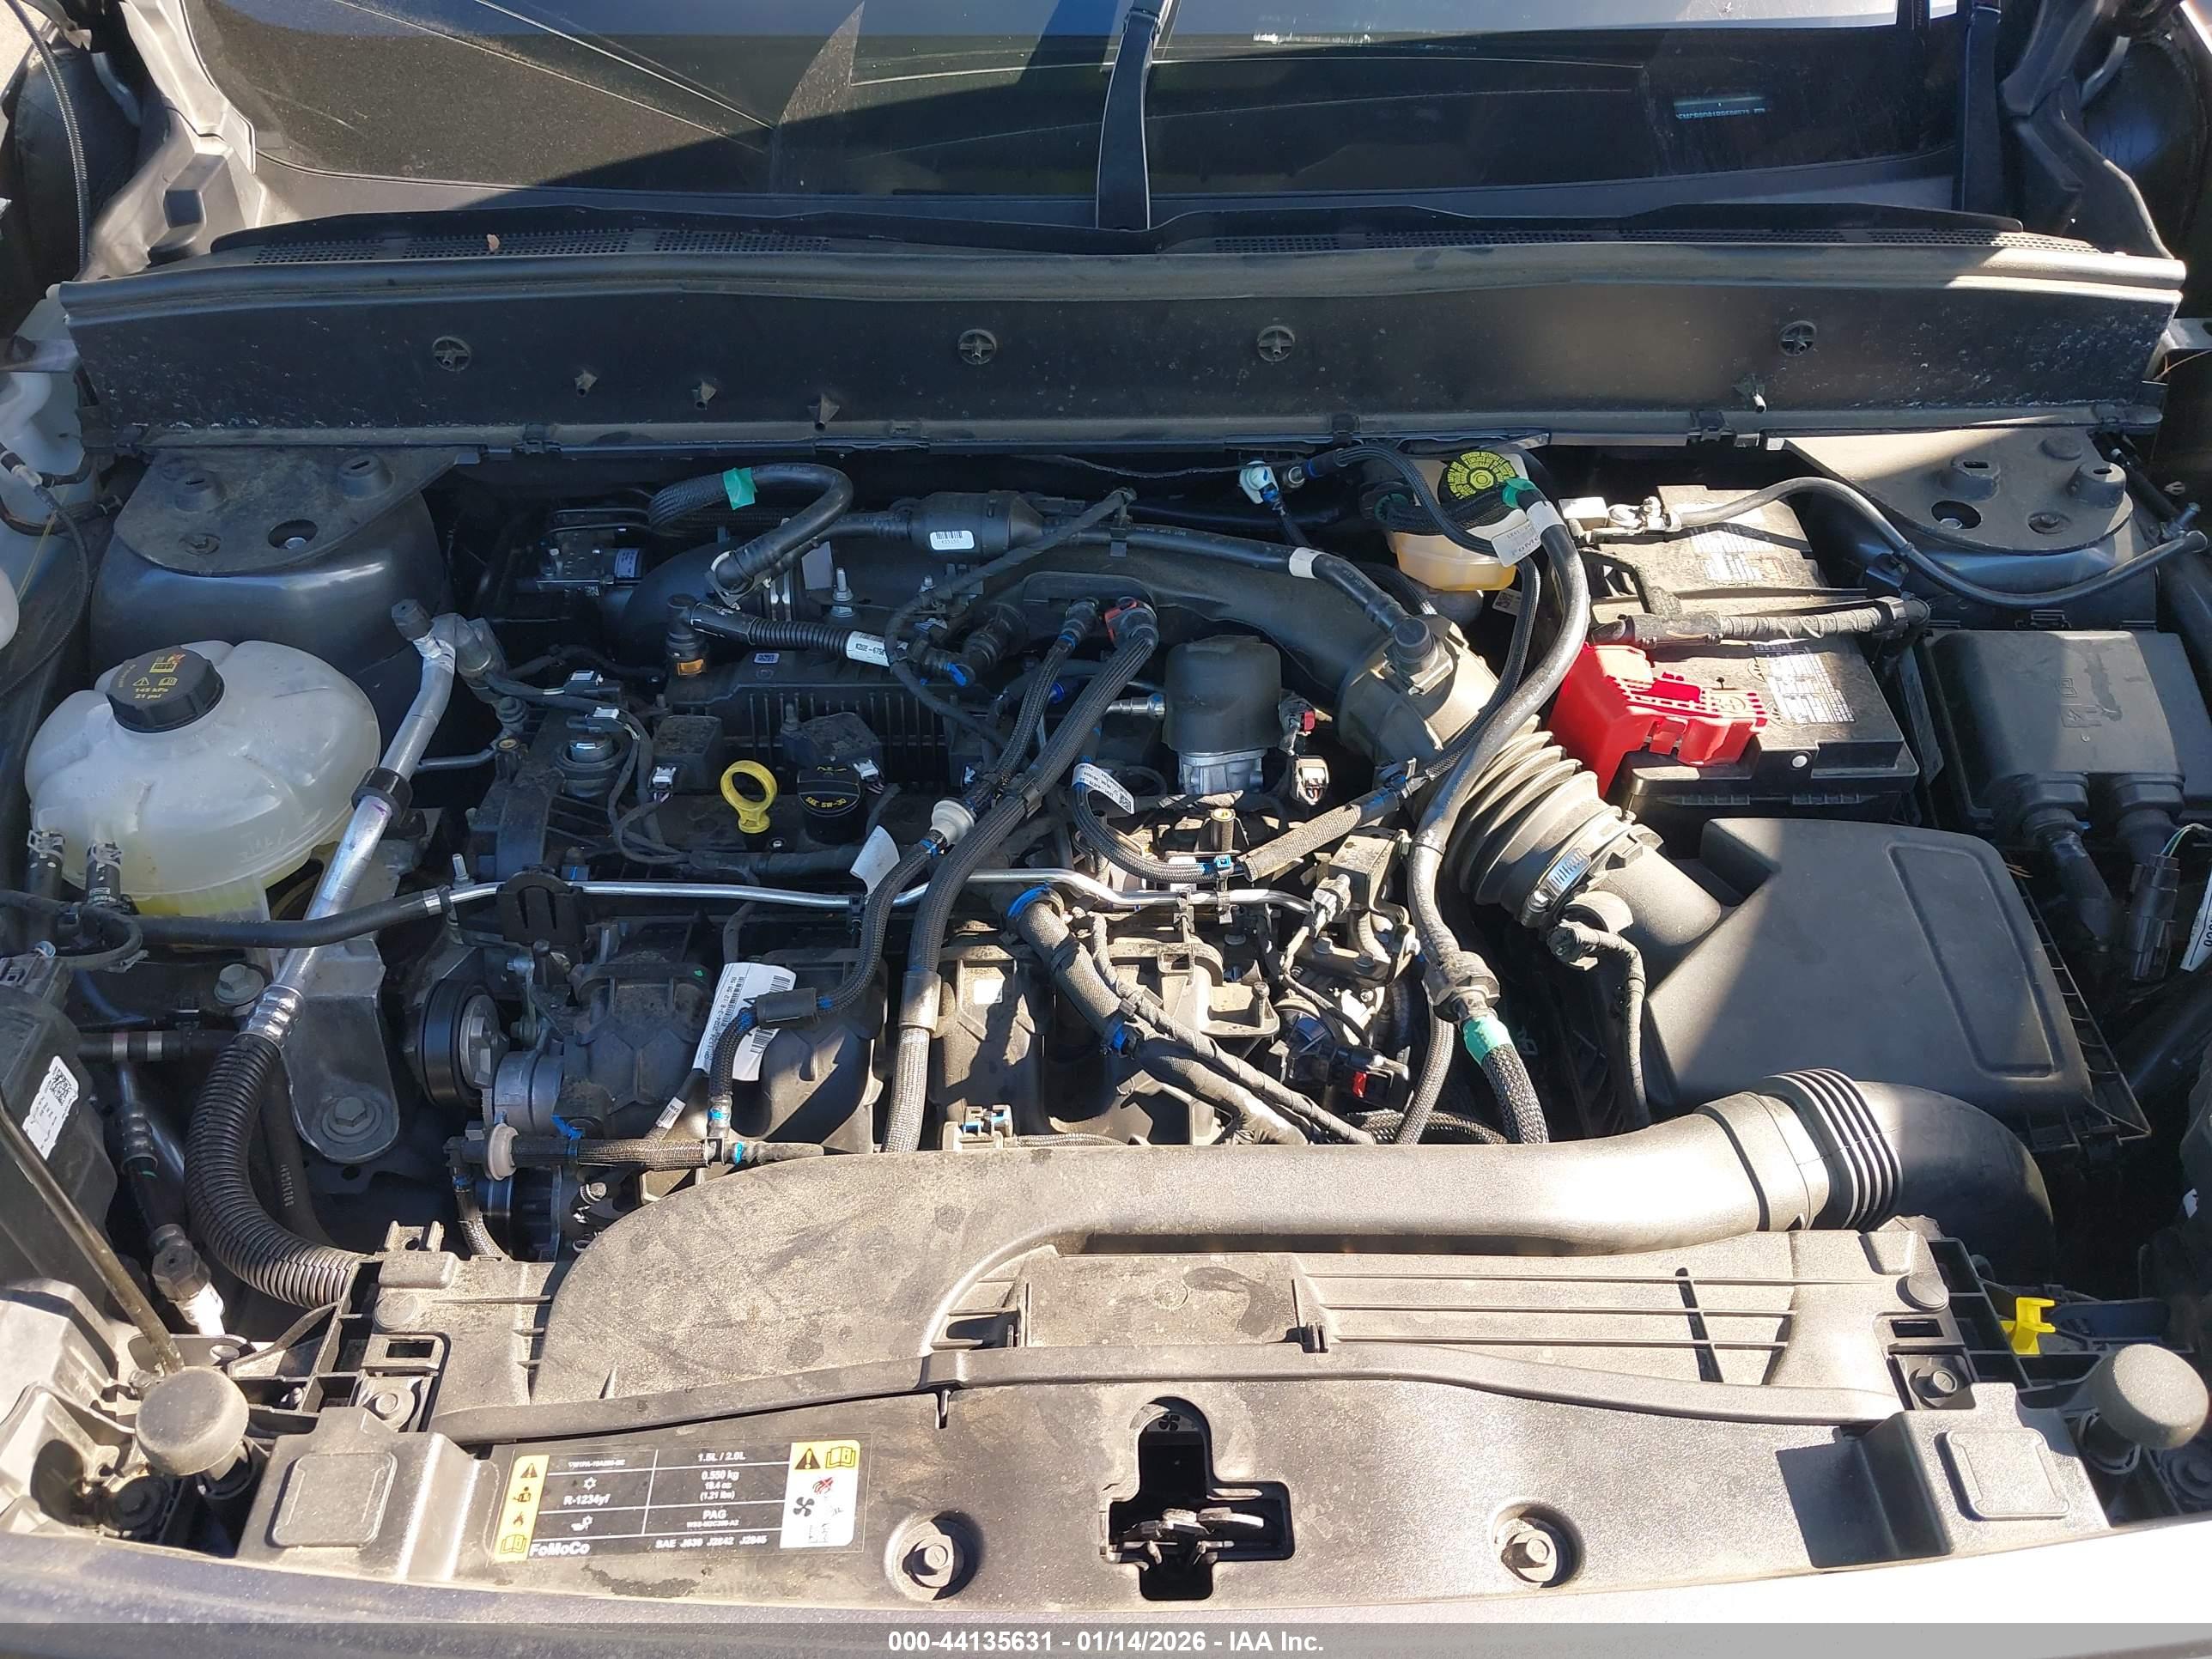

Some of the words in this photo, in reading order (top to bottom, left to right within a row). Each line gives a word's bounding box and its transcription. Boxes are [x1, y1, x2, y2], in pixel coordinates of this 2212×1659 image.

[805, 797, 820, 806] SAE
[821, 798, 847, 807] 5W-30
[697, 1452, 718, 1462] 1.5L
[726, 1451, 746, 1461] 2.0L
[701, 1470, 726, 1480] 0.550
[727, 1469, 739, 1481] kg
[563, 1493, 611, 1506] R-1234yf
[702, 1509, 726, 1520] PAG
[529, 1540, 590, 1557] FoMoCo
[655, 1539, 677, 1549] SAE
